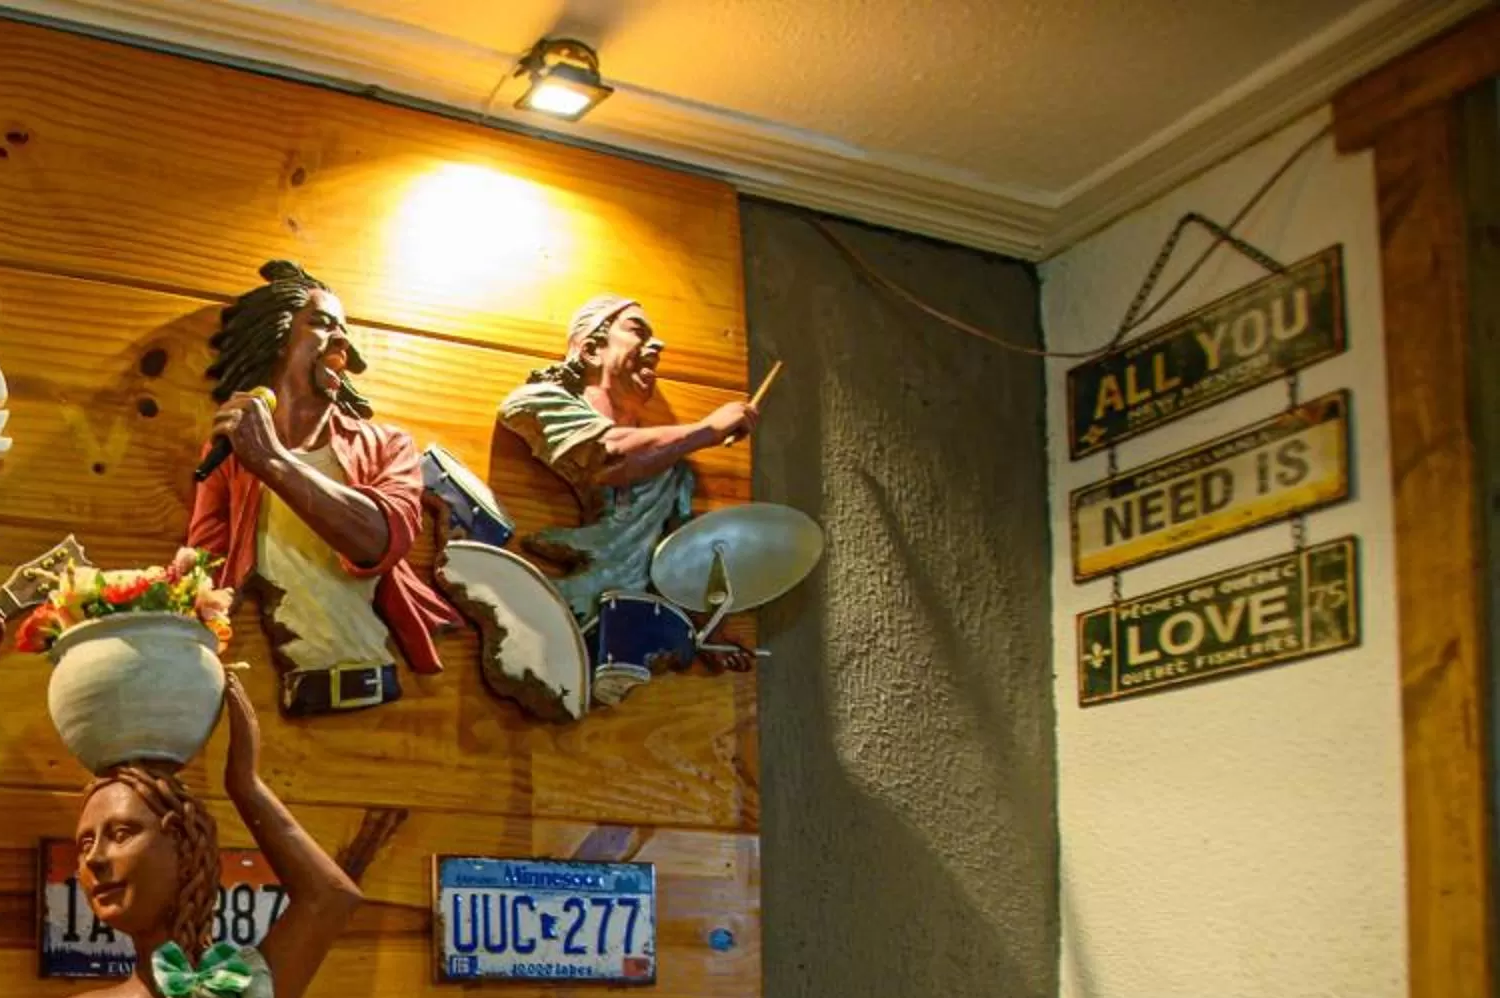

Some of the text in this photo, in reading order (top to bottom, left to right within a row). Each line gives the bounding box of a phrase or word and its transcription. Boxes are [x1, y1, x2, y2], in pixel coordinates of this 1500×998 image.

[1093, 352, 1181, 419] ALL
[1196, 288, 1310, 370] YOU
[1102, 467, 1235, 547] NEED
[1256, 439, 1311, 495] IS
[1126, 586, 1296, 666] LOVE
[452, 894, 640, 955] UUC 277
